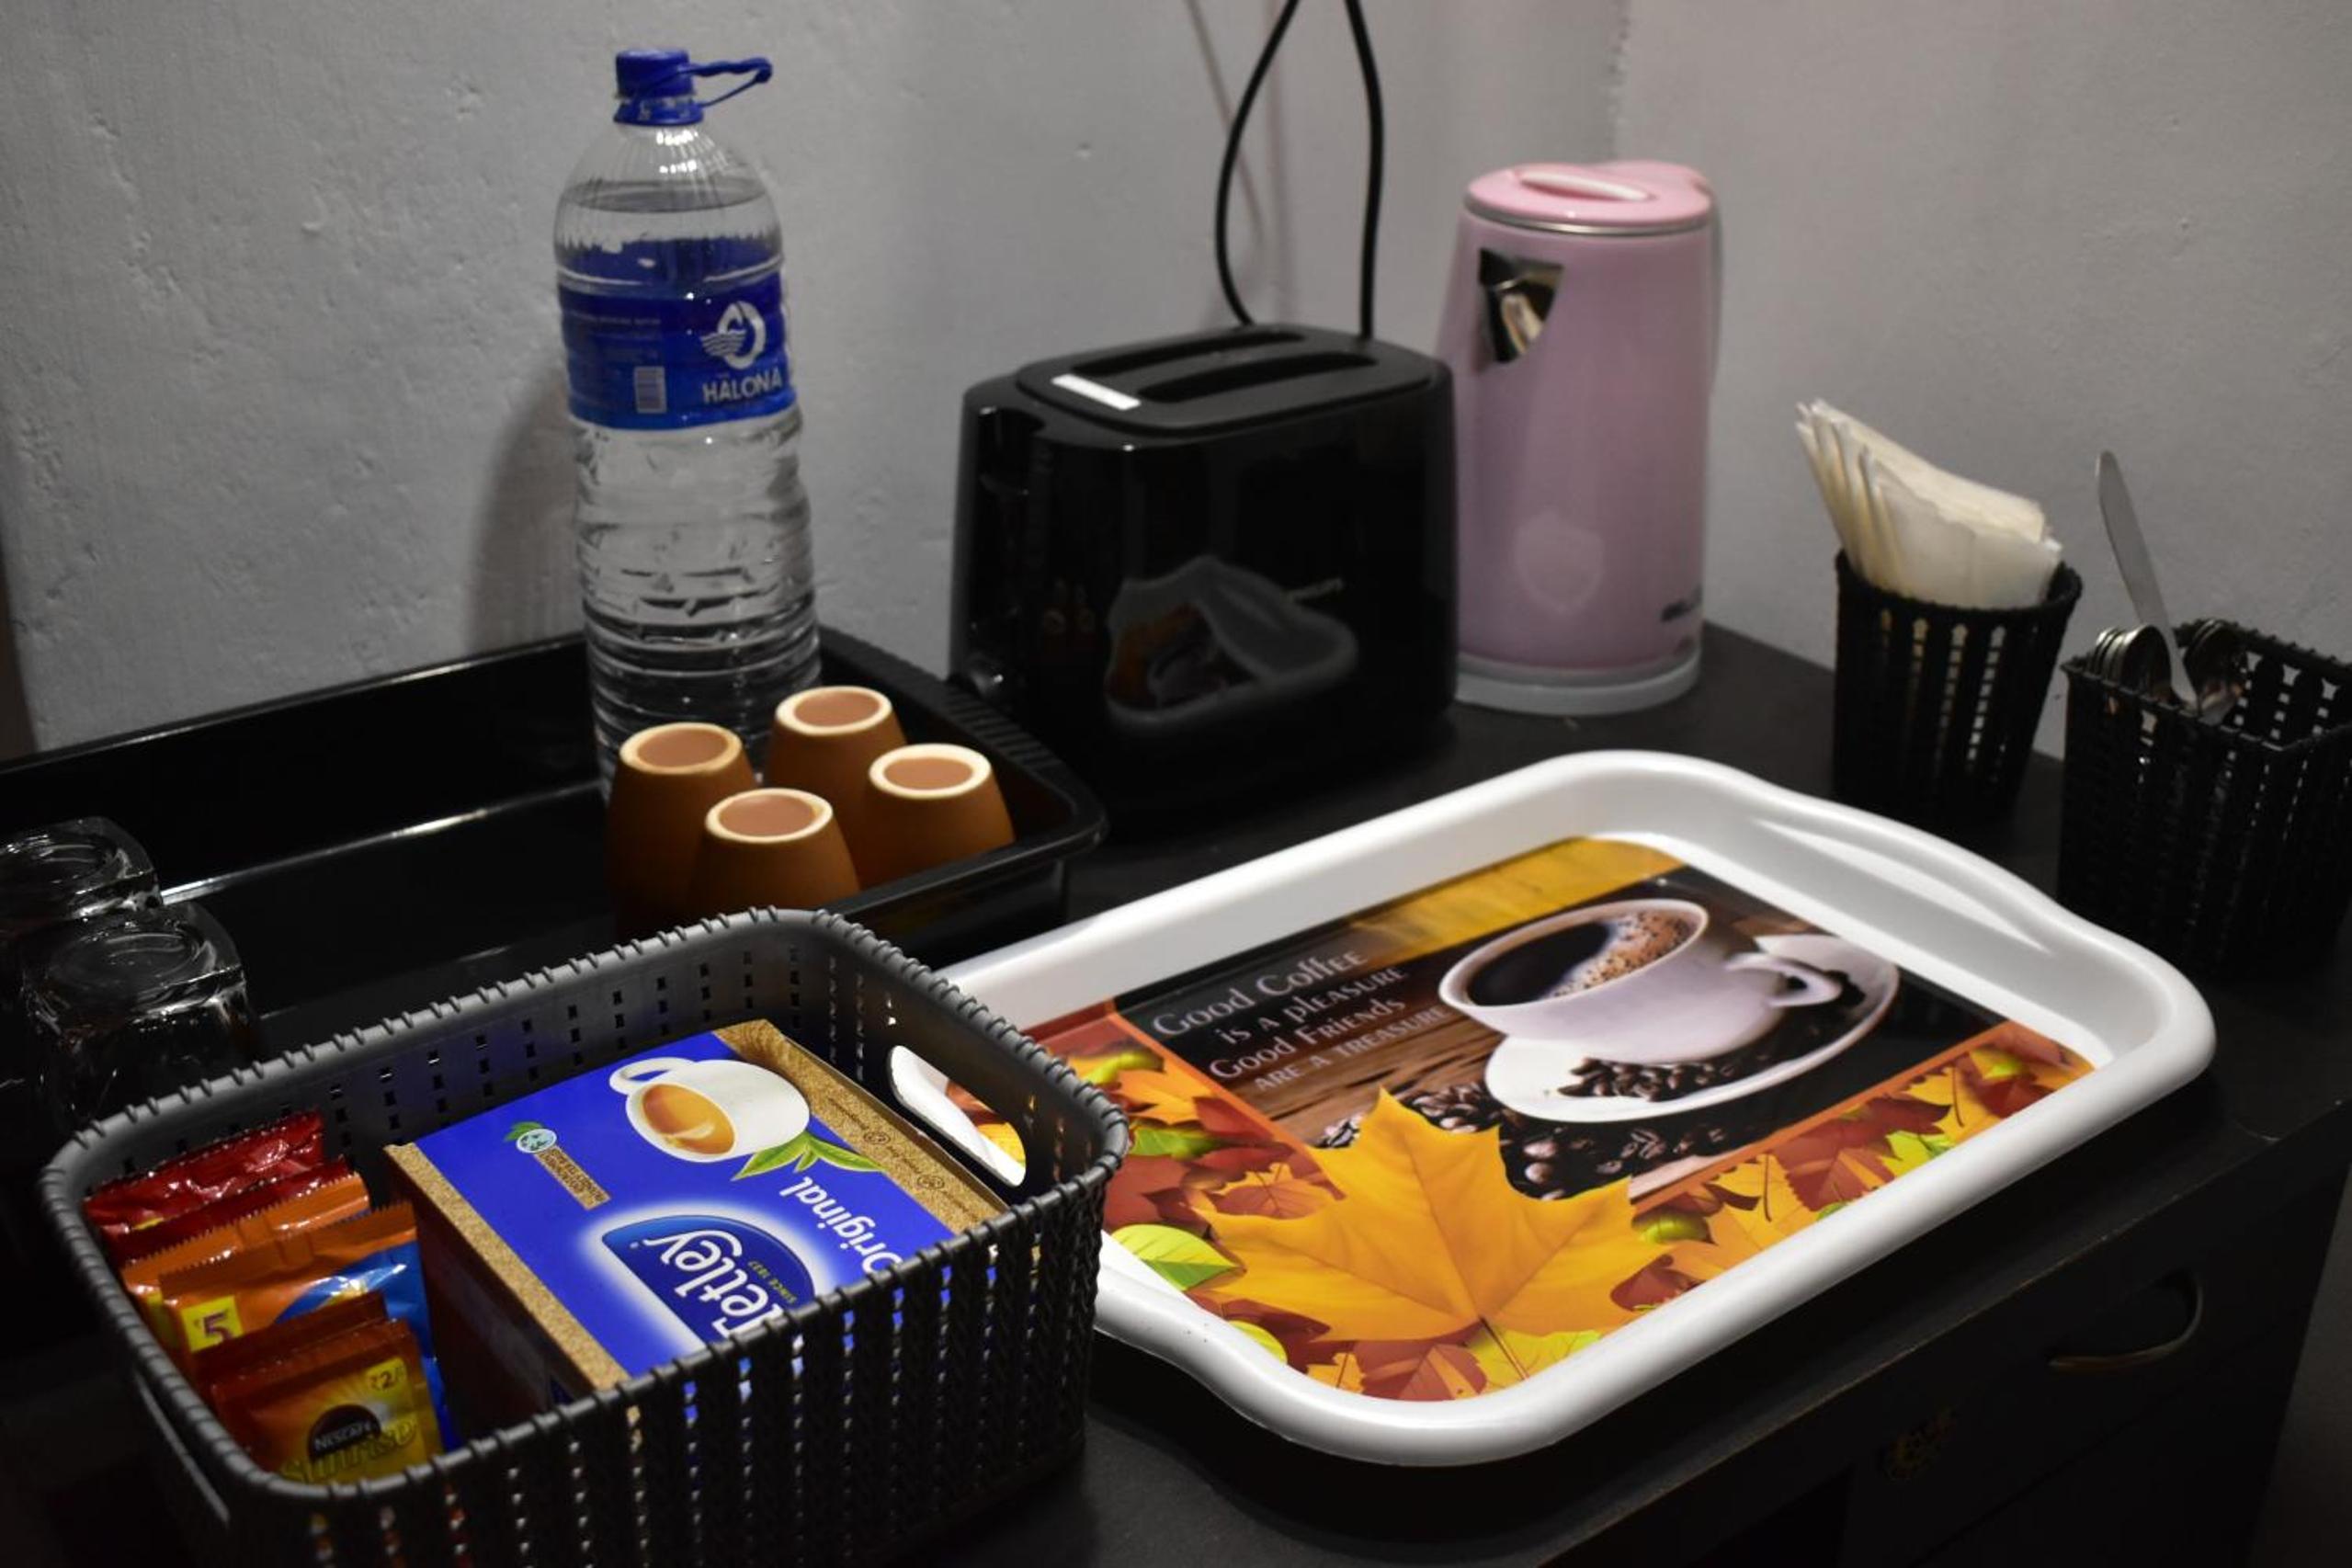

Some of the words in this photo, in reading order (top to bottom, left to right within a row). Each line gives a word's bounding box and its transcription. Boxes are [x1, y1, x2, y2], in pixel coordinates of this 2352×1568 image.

[1153, 987, 1256, 1035] Good
[1209, 1035, 1297, 1079] Good
[1215, 1028, 1252, 1045] is
[778, 1176, 903, 1276] Original
[642, 1230, 784, 1338] Tetley
